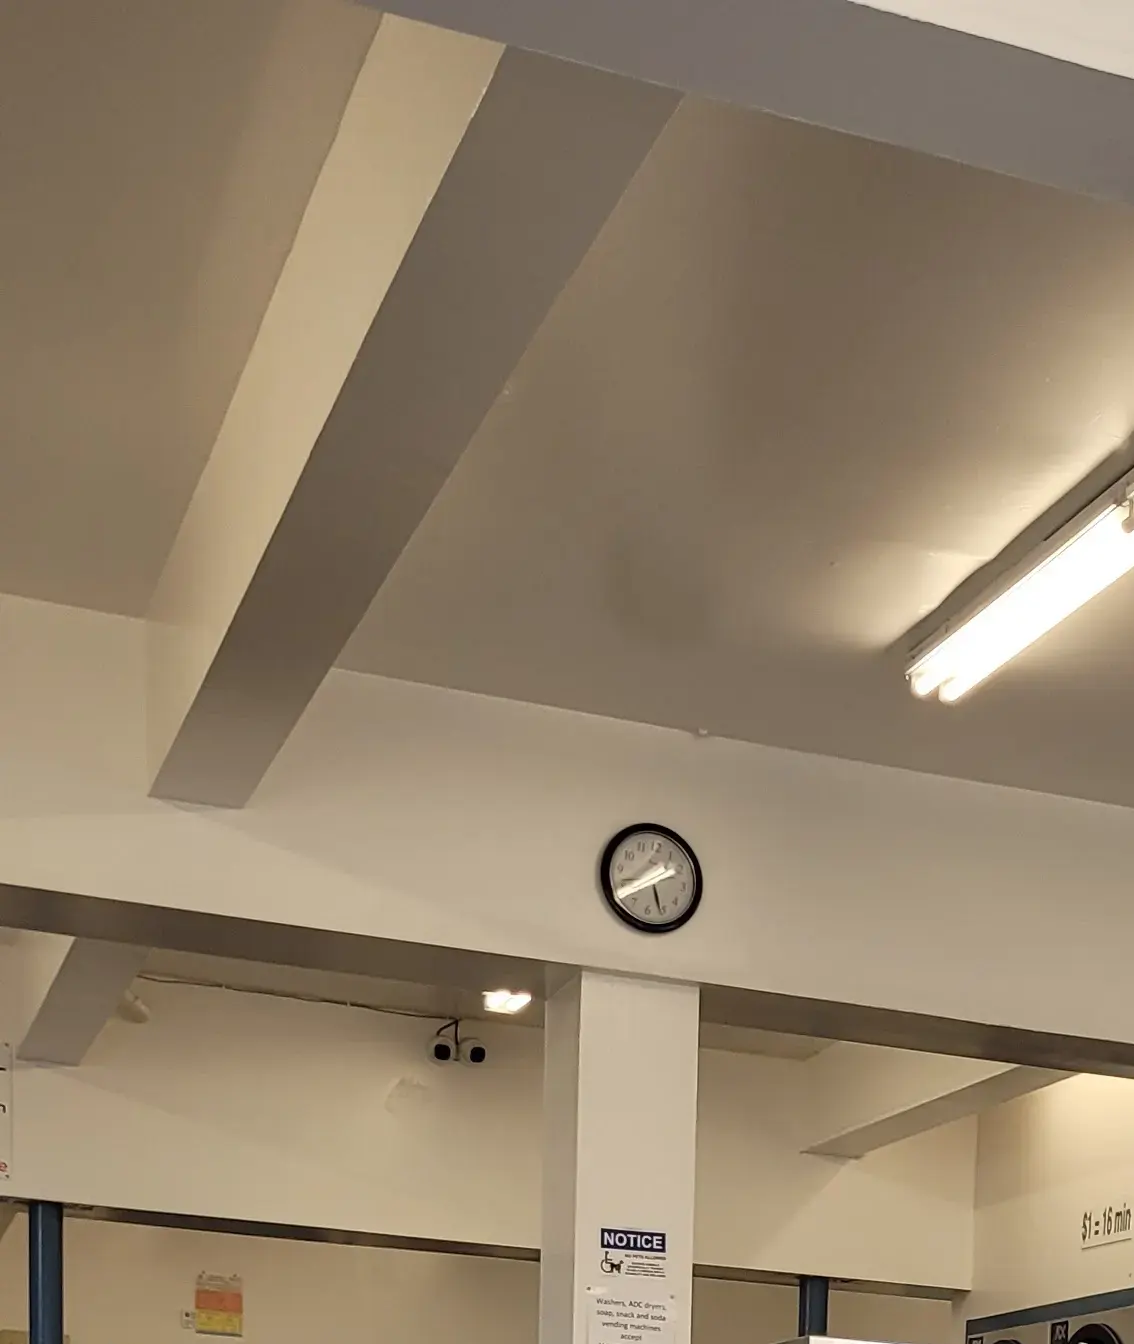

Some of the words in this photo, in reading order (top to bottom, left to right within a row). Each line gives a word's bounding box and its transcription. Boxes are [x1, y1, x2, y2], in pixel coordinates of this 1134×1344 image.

[637, 841, 646, 852] 11
[650, 840, 662, 853] 12
[624, 850, 635, 861] 10
[1081, 1211, 1092, 1244] $1
[1102, 1206, 1113, 1236] 16
[1113, 1202, 1132, 1234] min
[603, 1231, 664, 1250] NOTICE
[628, 1301, 643, 1309] ADC
[616, 1311, 635, 1319] snack
[650, 1313, 667, 1322] soda
[602, 1321, 629, 1331] vending
